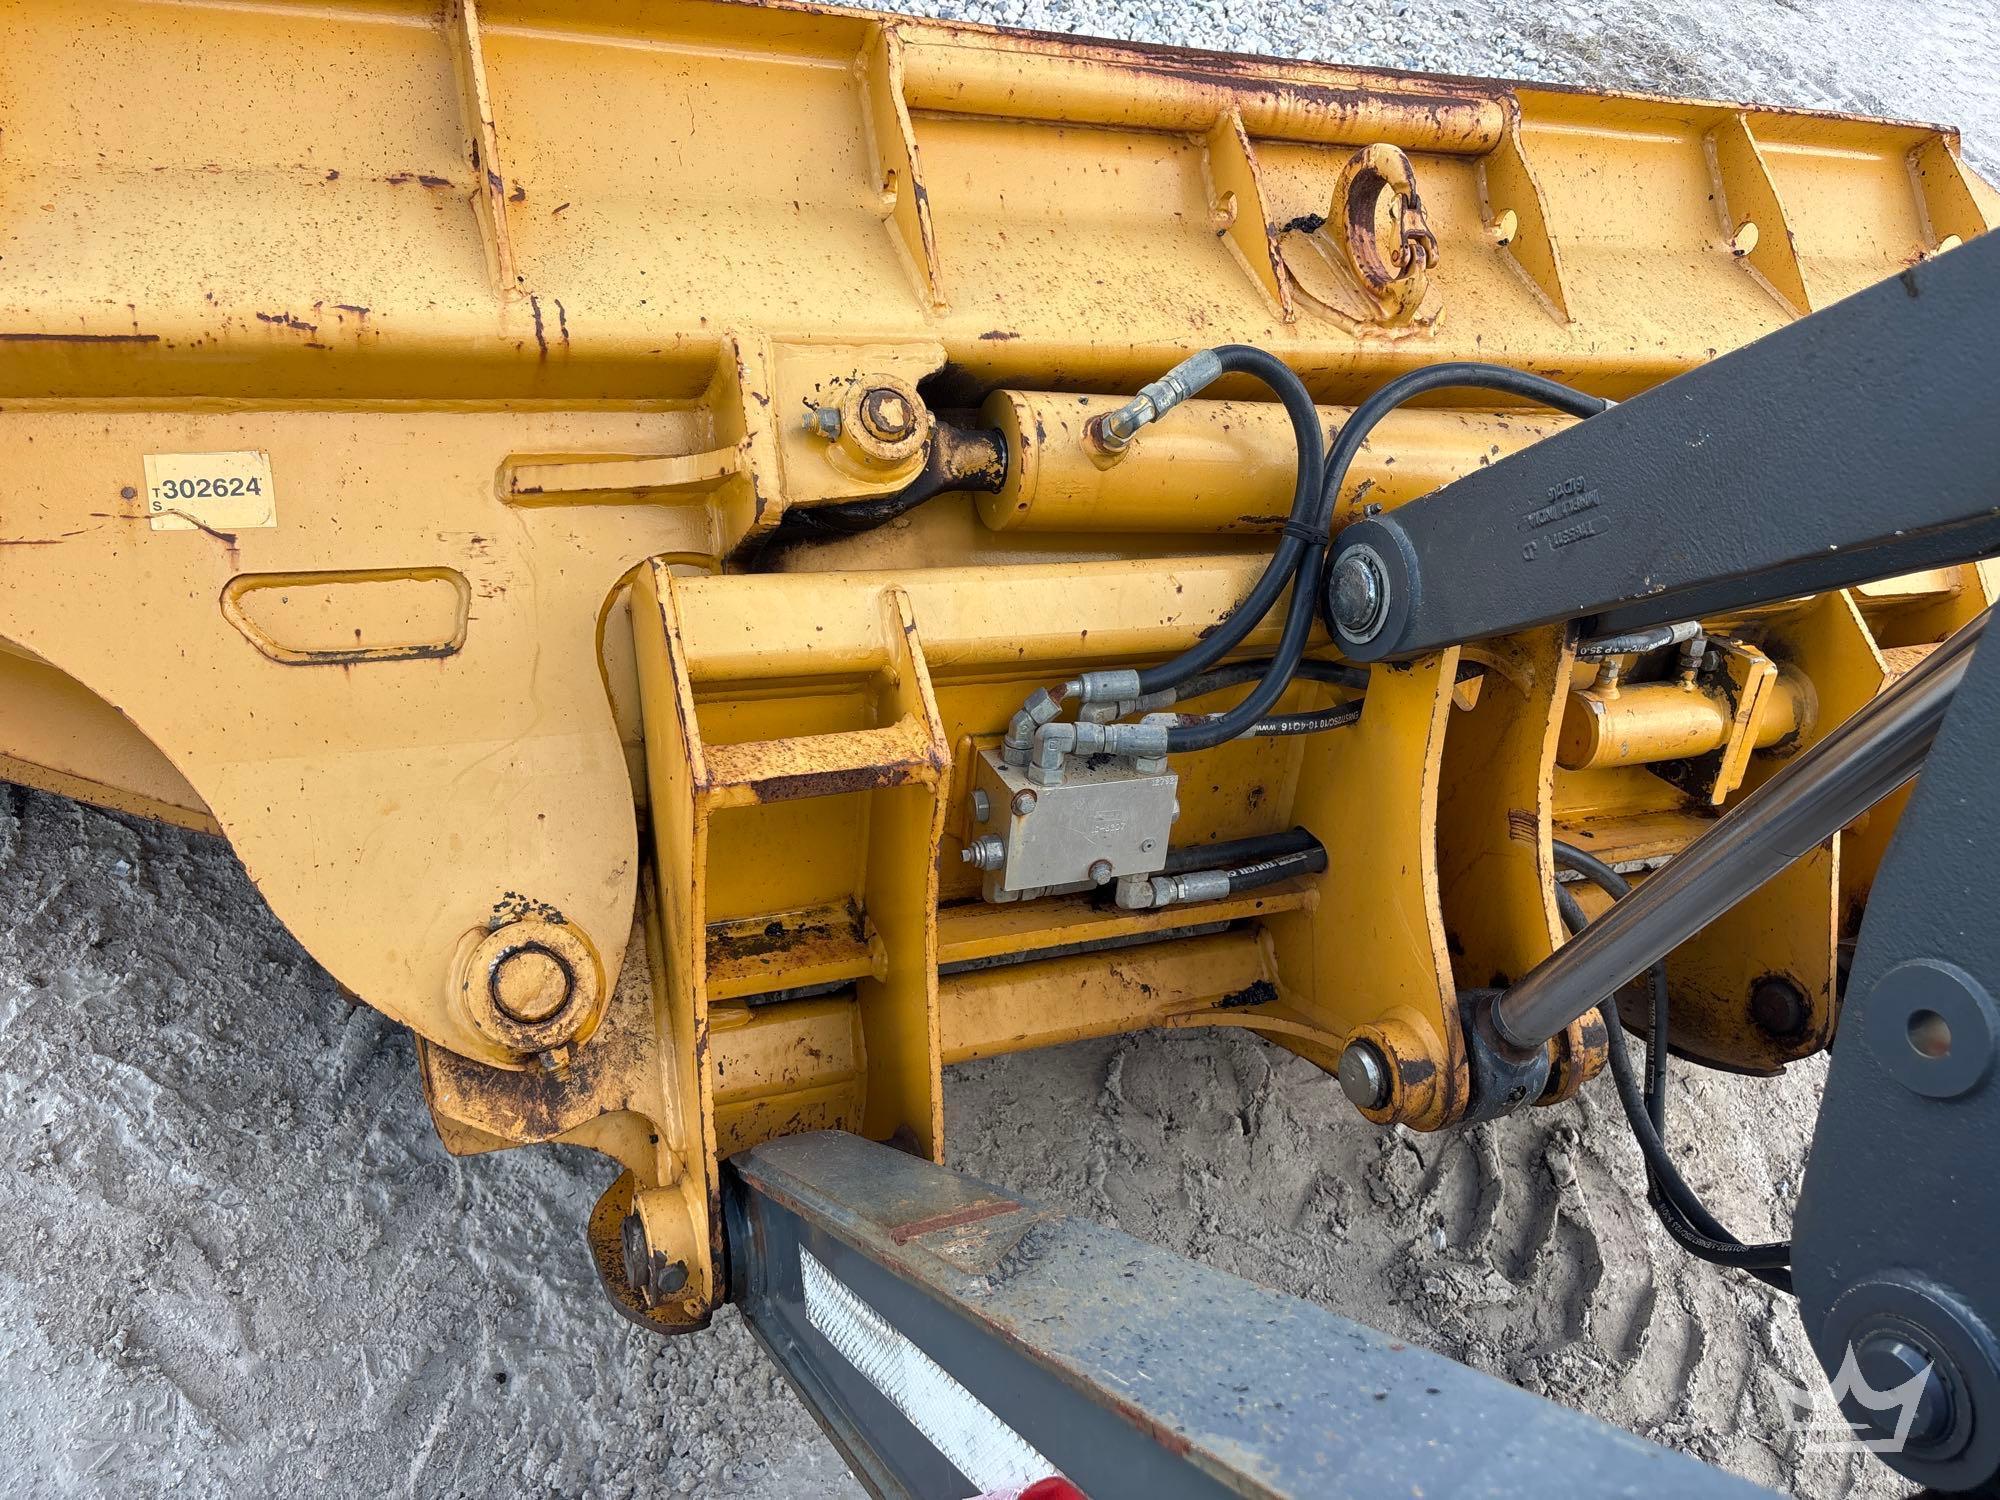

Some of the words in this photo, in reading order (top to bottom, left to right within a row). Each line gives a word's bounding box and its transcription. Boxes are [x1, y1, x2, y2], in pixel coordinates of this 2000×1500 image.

[152, 487, 160, 498] T
[162, 477, 261, 499] 302624
[152, 501, 162, 511] S
